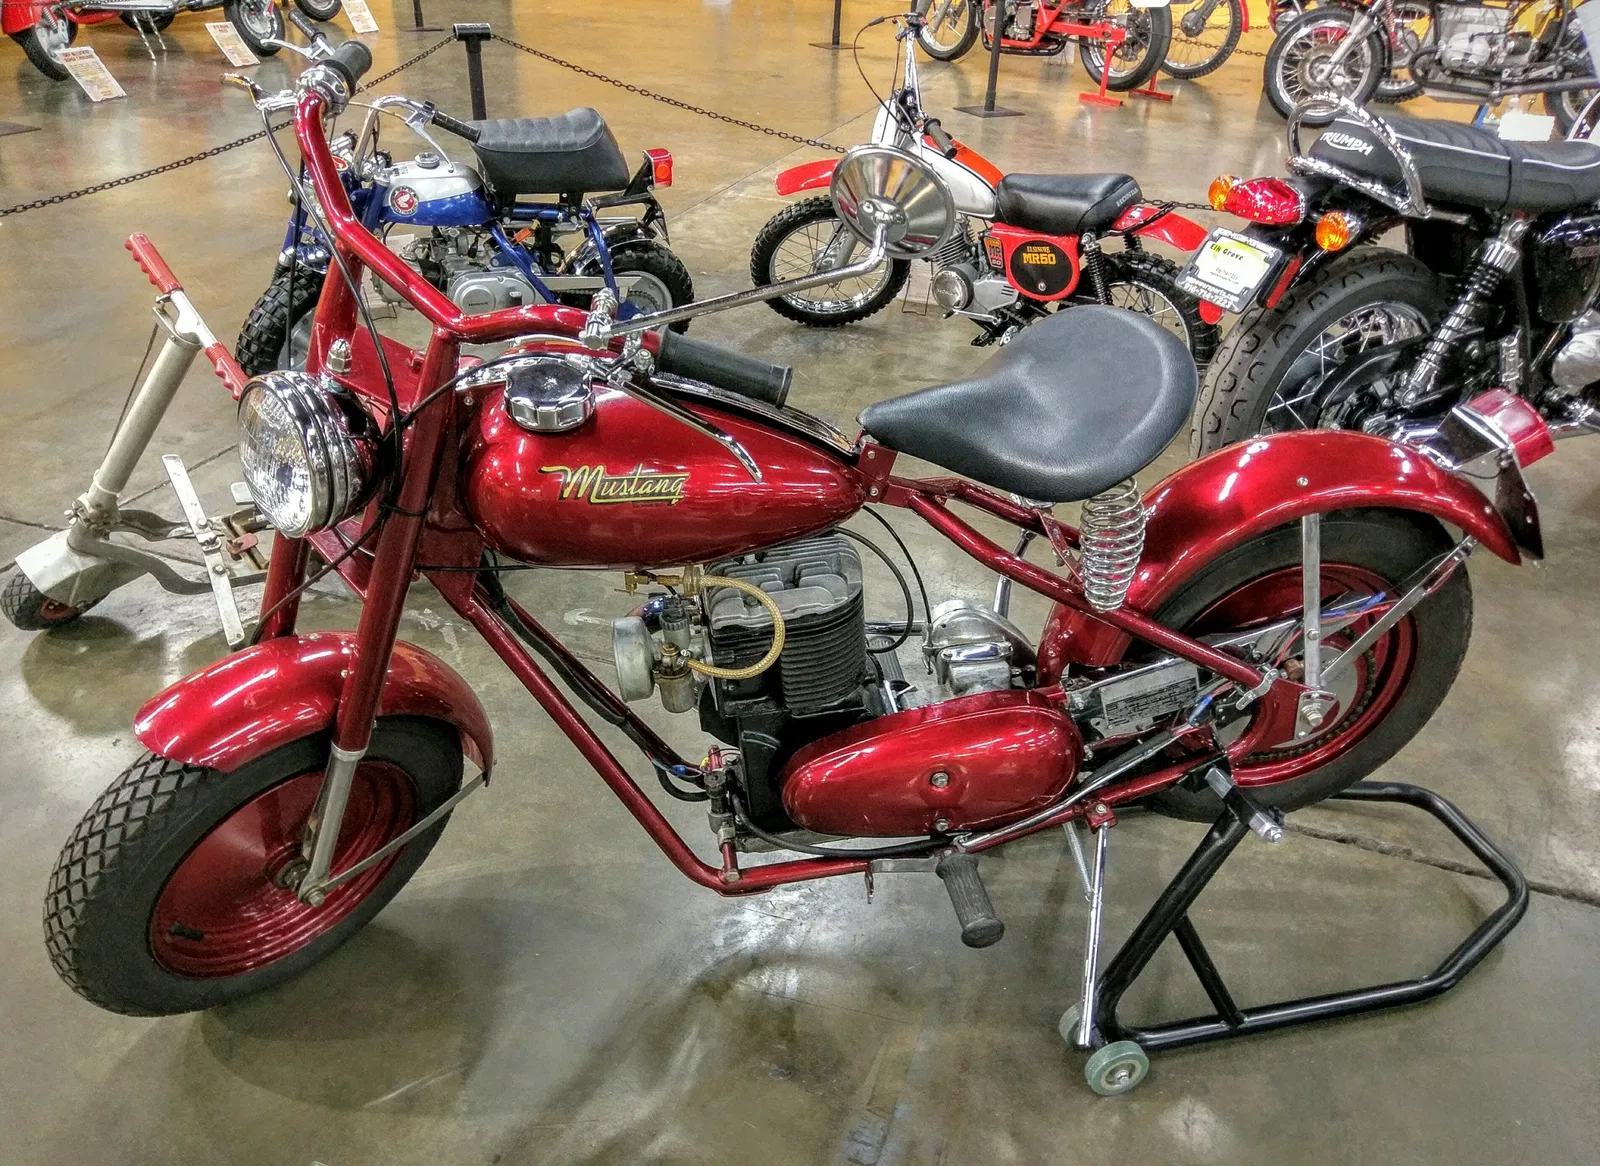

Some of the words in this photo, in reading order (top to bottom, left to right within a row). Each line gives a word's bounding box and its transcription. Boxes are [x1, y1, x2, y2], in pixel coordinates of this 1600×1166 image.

[1319, 132, 1374, 156] TRIUMPH
[1115, 187, 1139, 207] HONDA
[1022, 253, 1057, 265] MR50
[1222, 248, 1244, 261] Grove
[538, 463, 690, 505] Mustang
